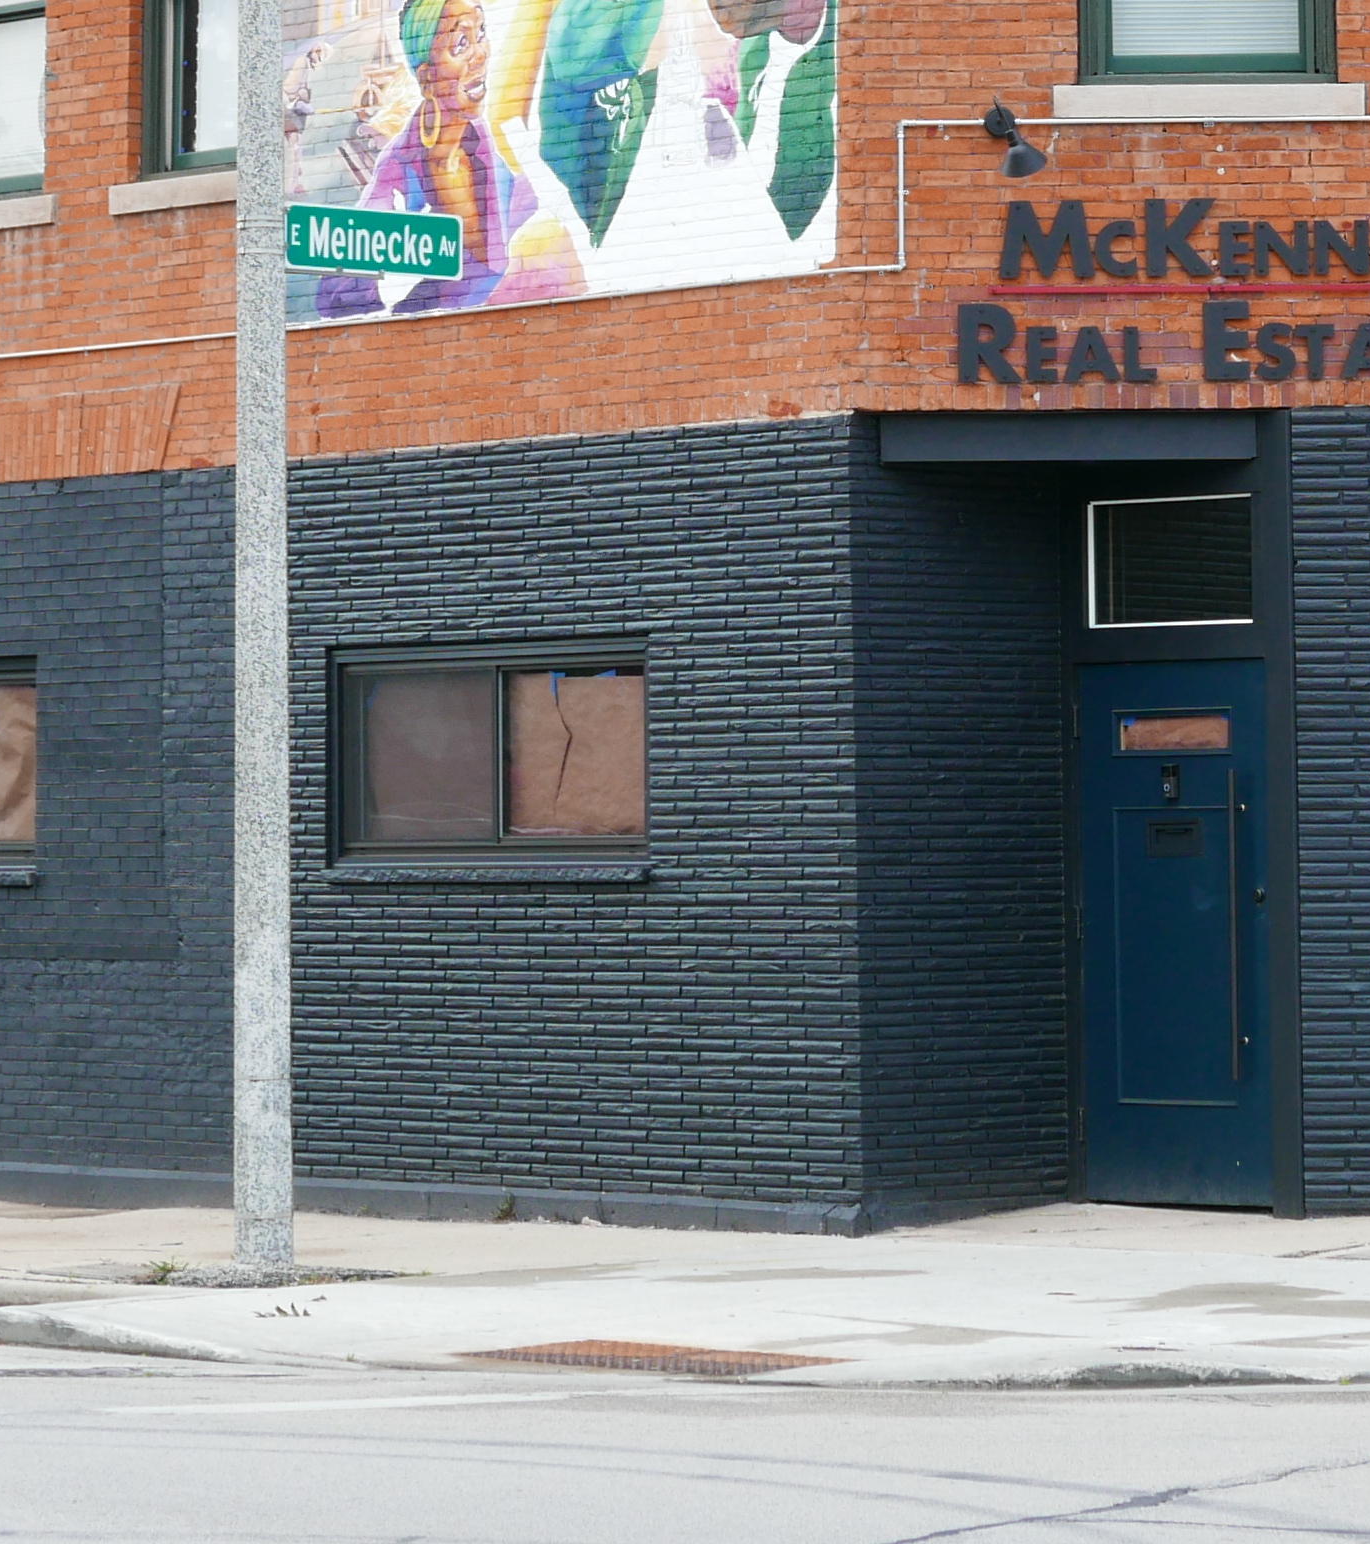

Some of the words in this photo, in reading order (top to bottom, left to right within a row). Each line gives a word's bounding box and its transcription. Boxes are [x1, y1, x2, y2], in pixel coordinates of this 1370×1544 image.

[291, 224, 301, 246] E
[309, 215, 433, 267] Meinecke
[438, 235, 457, 258] Av
